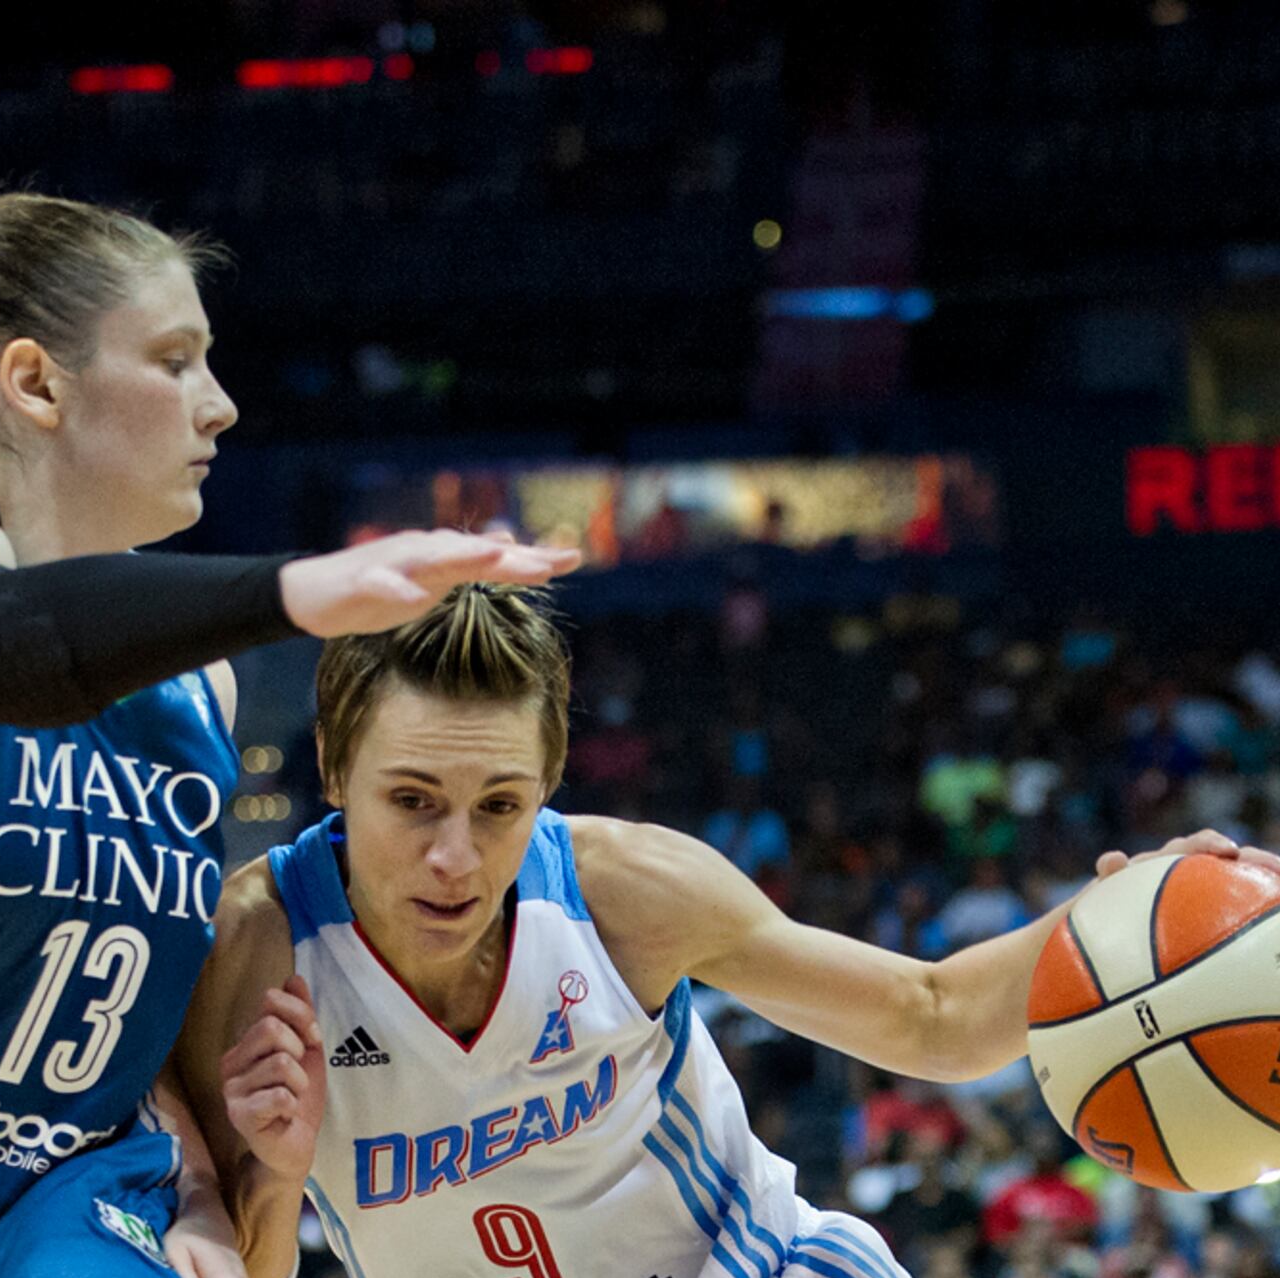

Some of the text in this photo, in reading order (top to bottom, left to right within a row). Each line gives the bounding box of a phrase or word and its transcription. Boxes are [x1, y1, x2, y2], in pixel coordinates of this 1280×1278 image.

[10, 737, 221, 838] MAYO
[330, 1050, 390, 1067] adidas
[354, 1055, 618, 1209] DREAM
